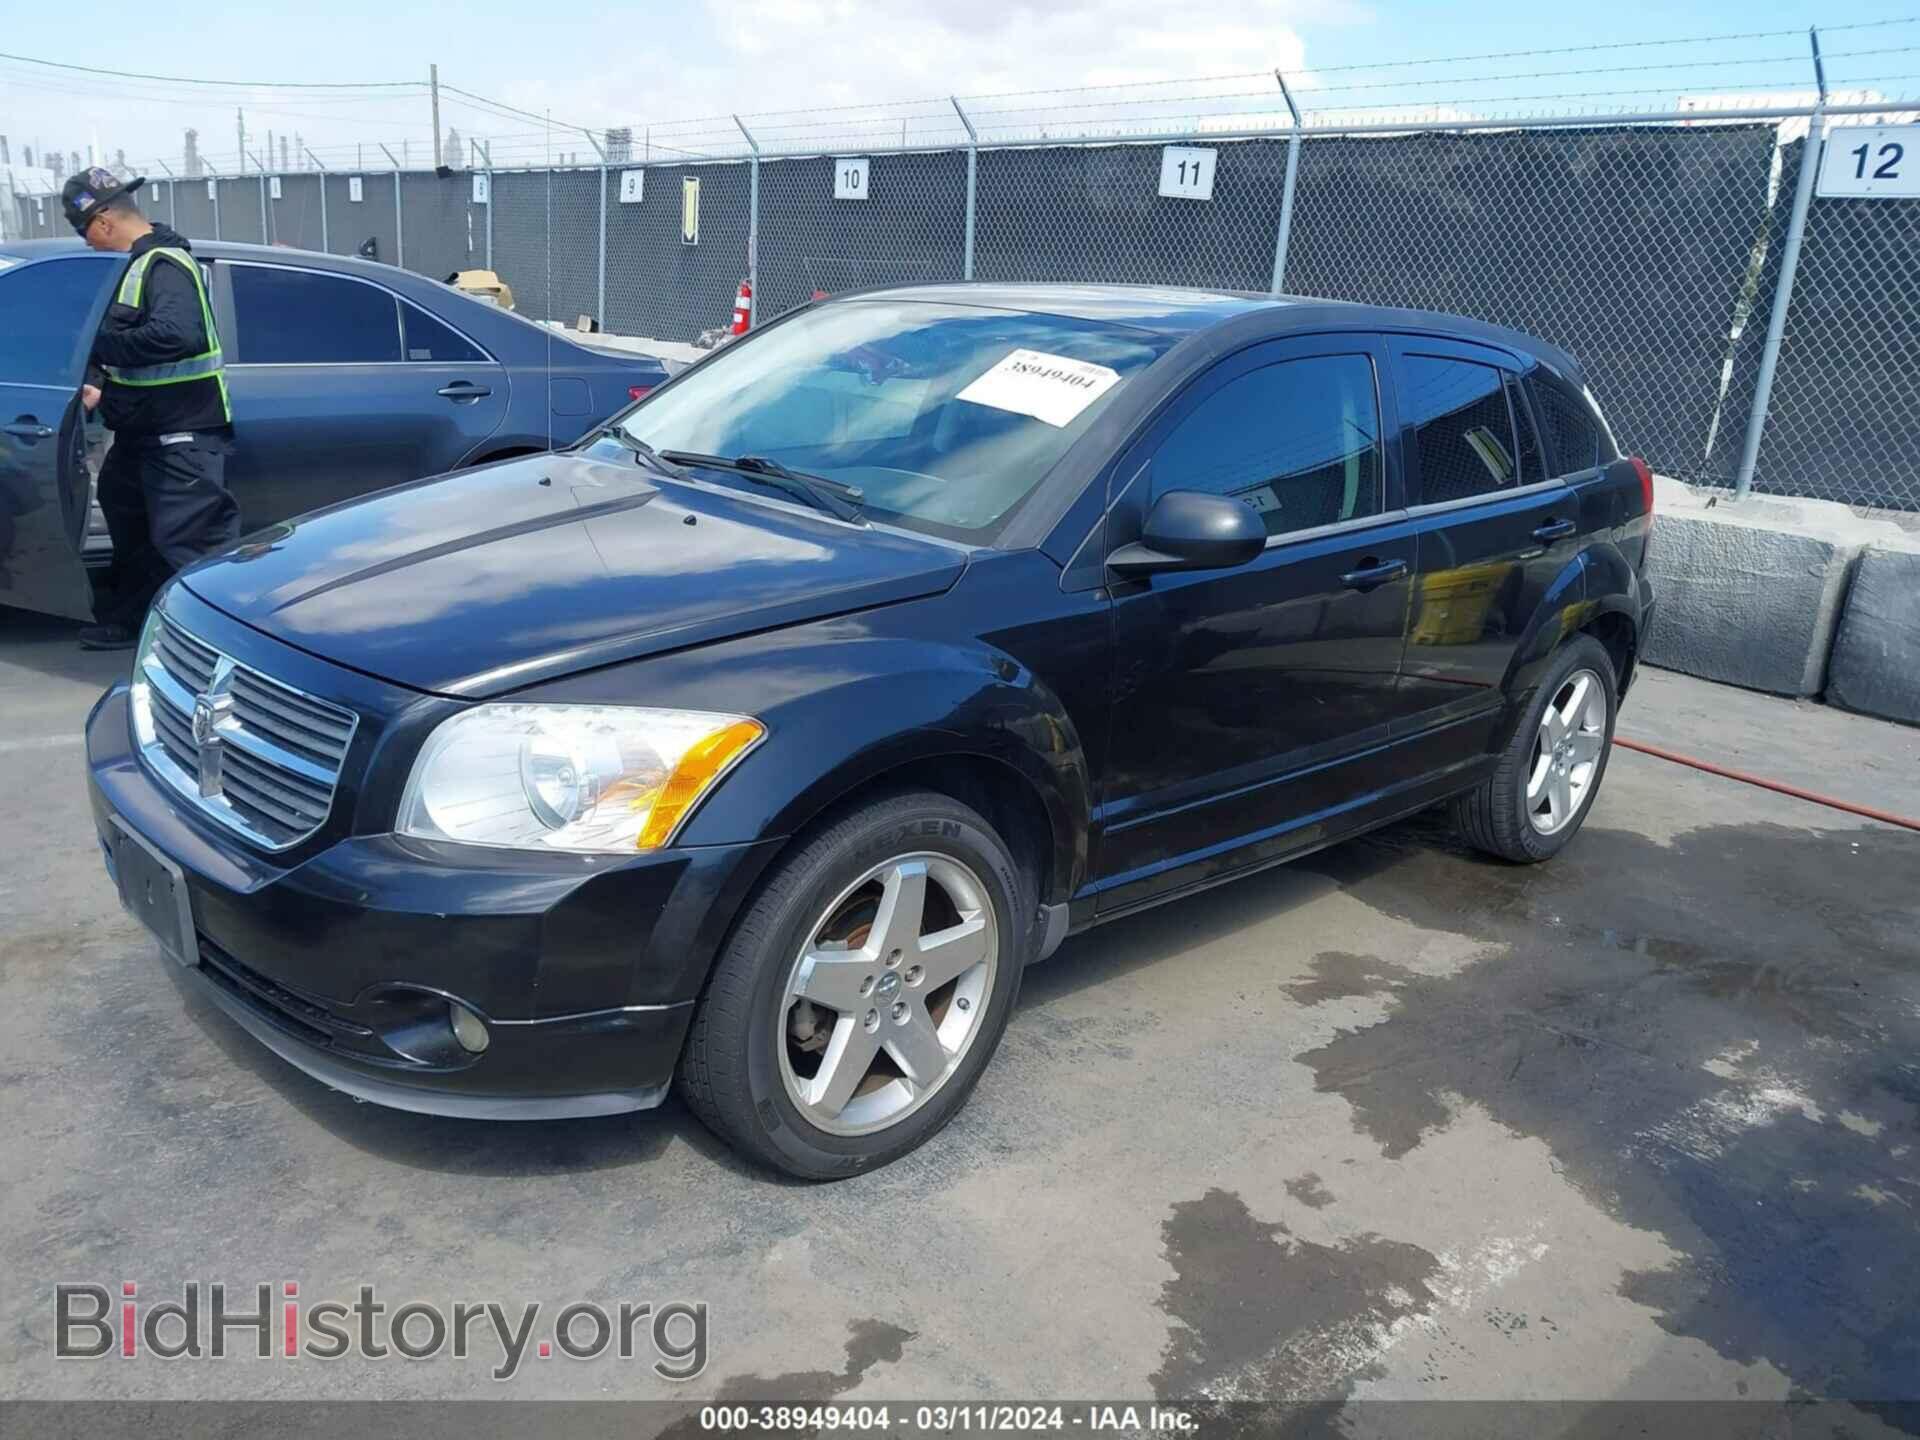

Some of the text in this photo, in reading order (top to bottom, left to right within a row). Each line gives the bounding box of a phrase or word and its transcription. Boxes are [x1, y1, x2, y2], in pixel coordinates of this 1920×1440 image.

[1852, 142, 1904, 179] 12
[844, 169, 860, 189] 10
[1178, 160, 1200, 186] 11
[629, 178, 635, 194] 9
